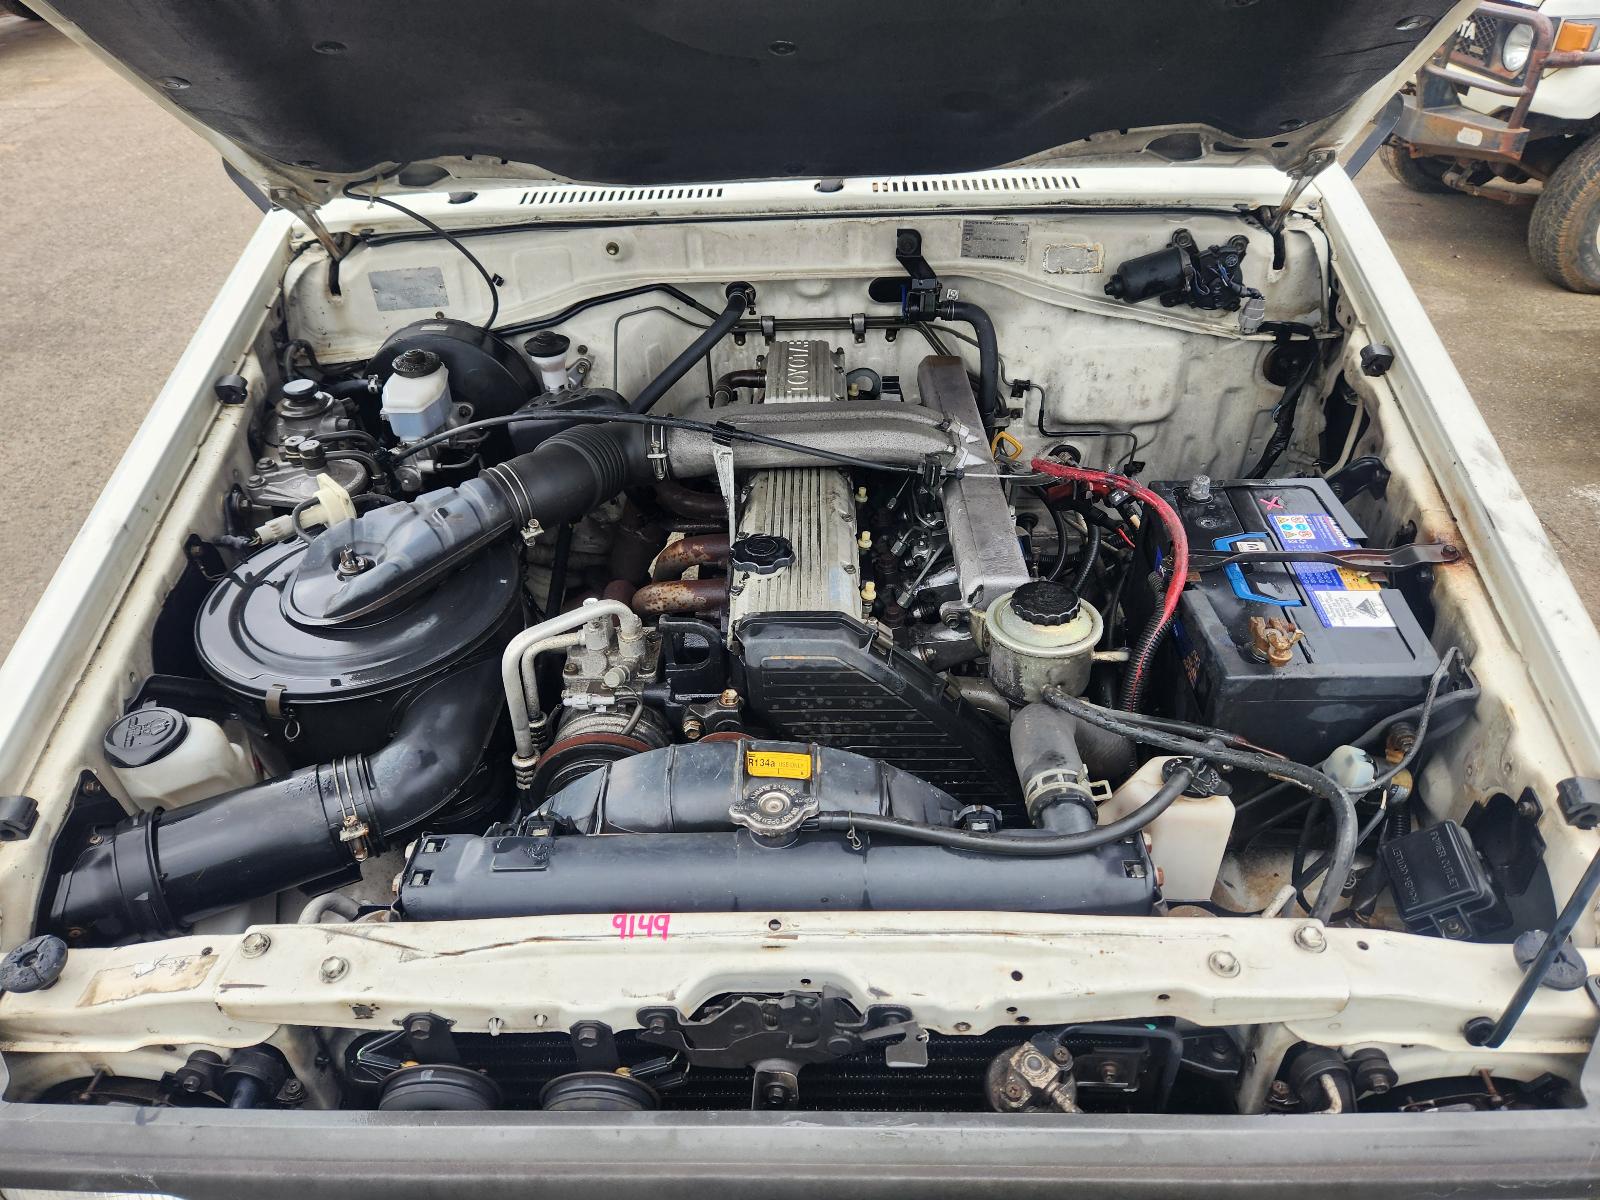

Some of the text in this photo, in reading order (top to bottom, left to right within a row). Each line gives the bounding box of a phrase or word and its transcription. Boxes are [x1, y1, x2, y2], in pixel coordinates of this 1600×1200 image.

[787, 341, 809, 393] TOYOTA
[748, 758, 775, 767] R134a
[612, 913, 670, 941] 9149
